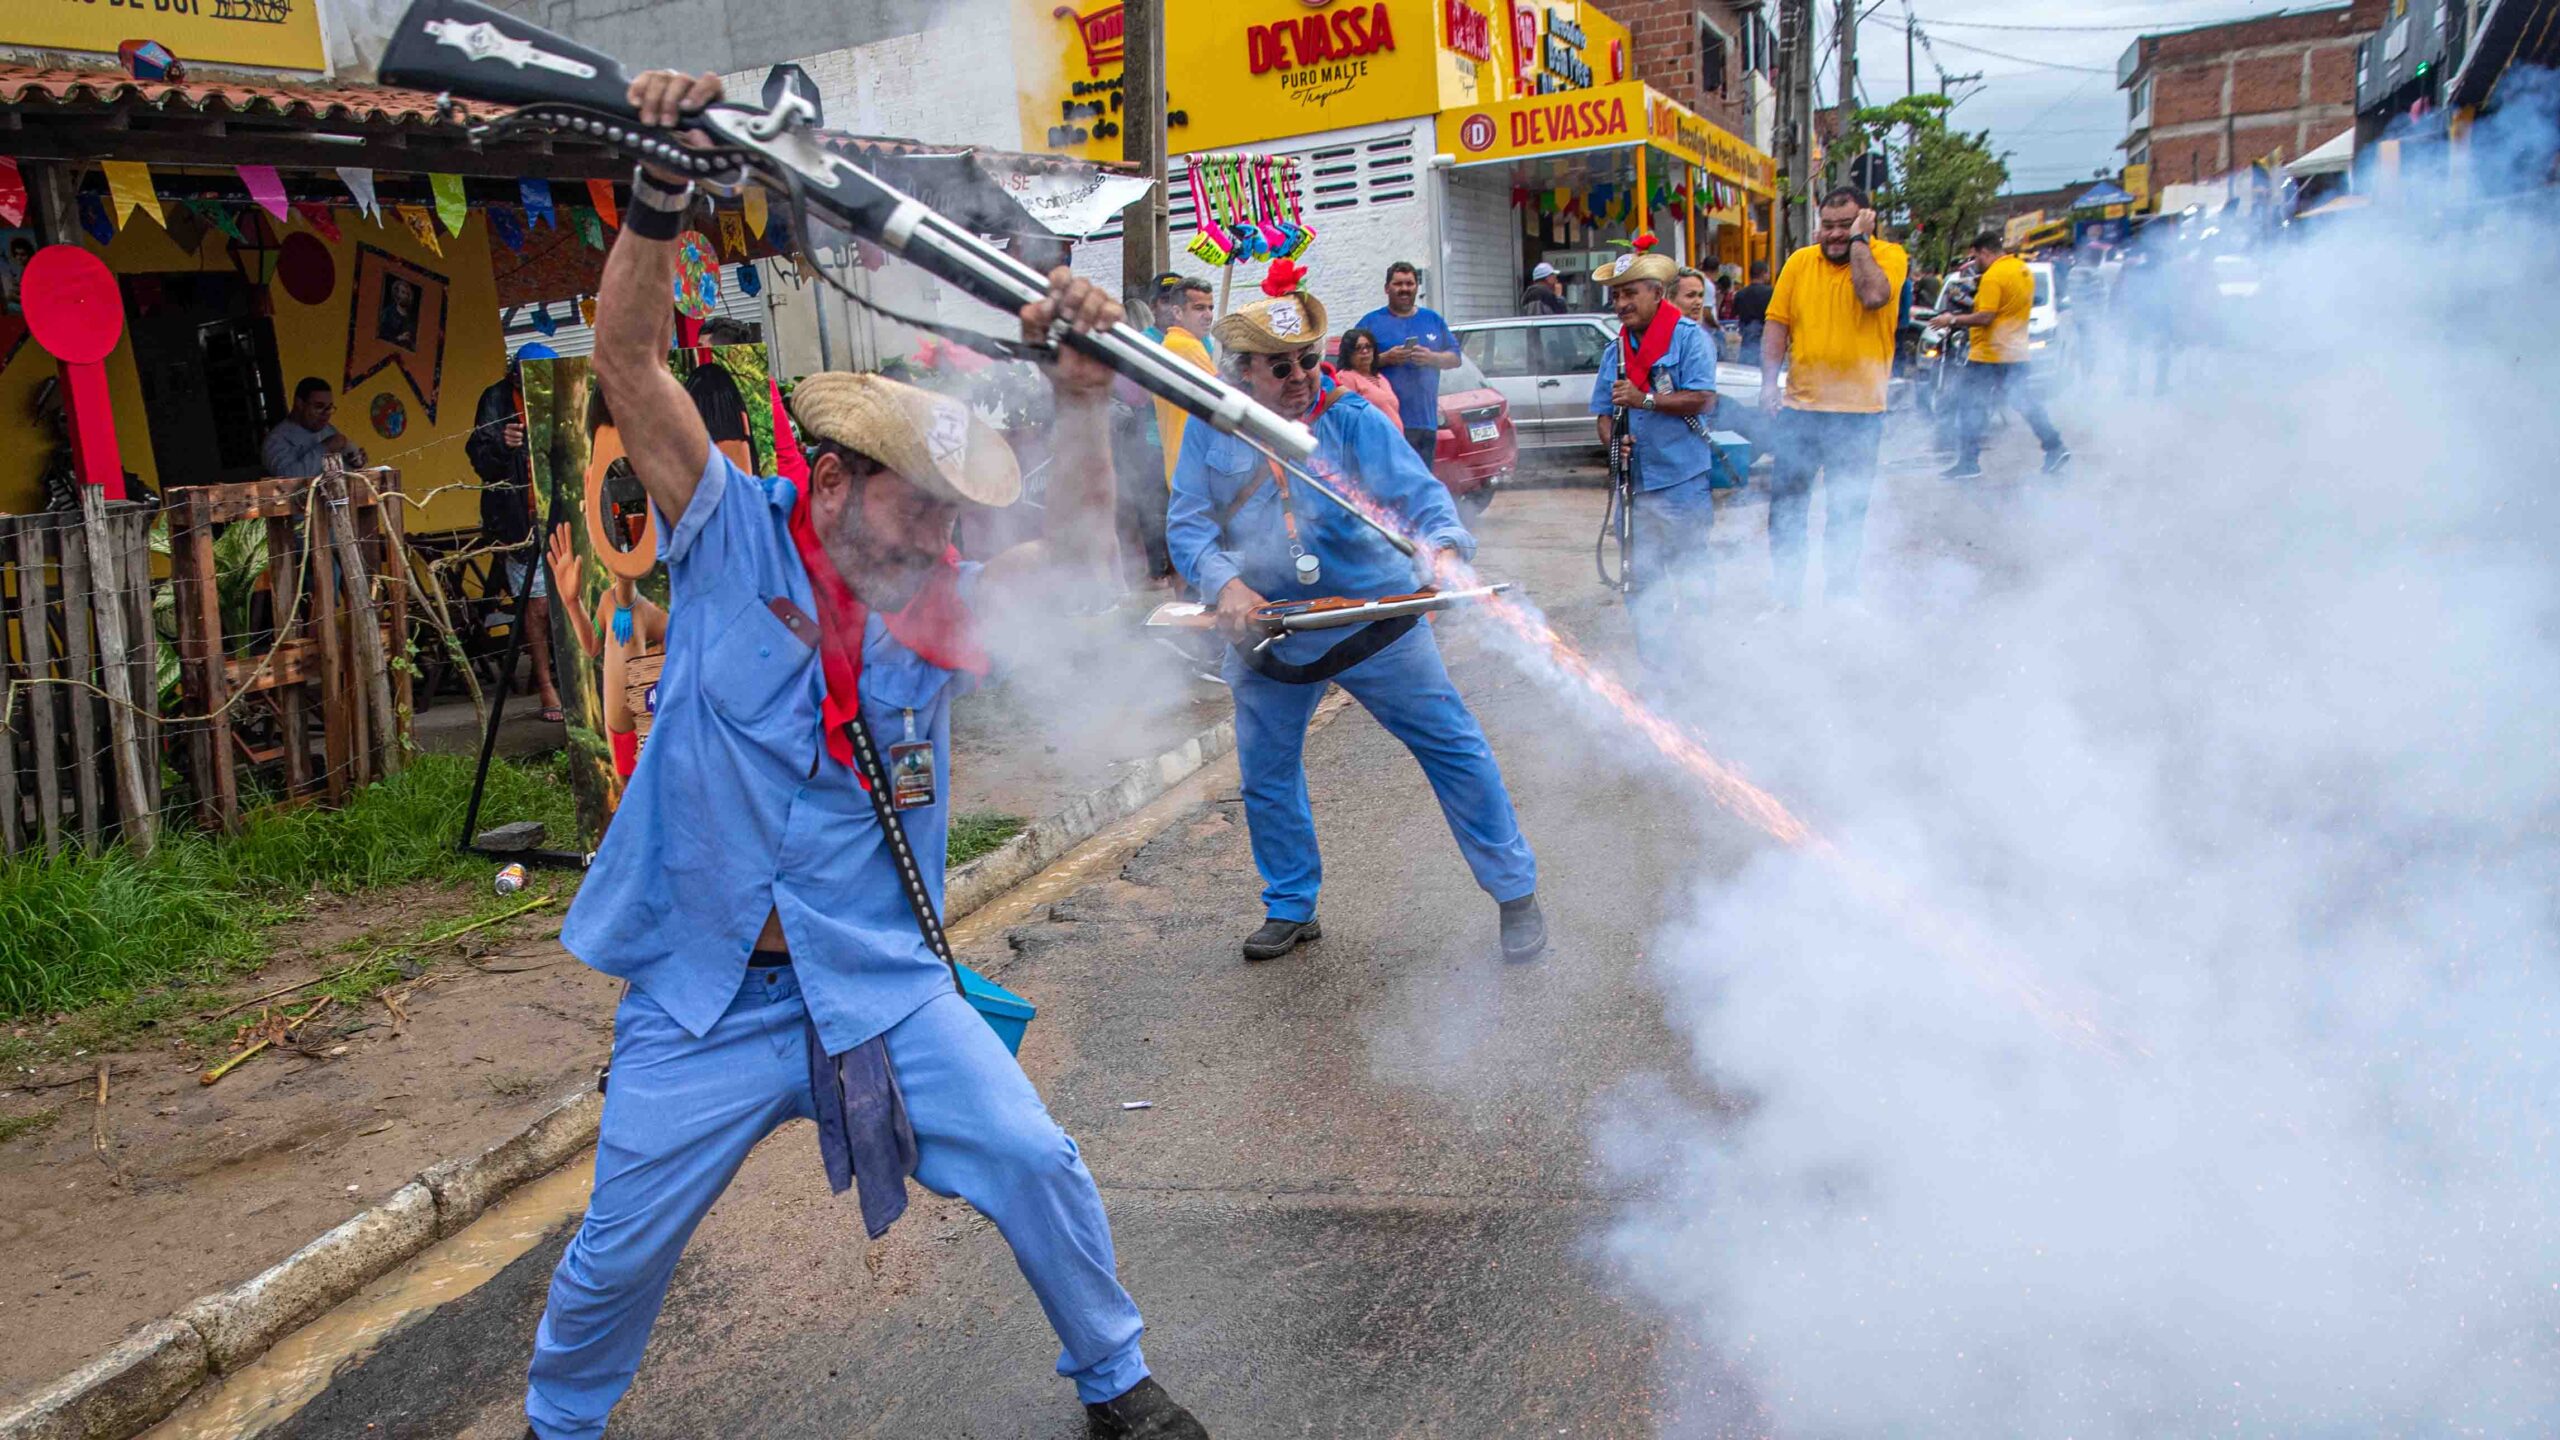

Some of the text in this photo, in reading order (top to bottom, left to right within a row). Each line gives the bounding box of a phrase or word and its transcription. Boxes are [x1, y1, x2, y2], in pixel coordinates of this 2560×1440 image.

[1248, 3, 1395, 74] DEVASSA
[1281, 61, 1368, 89] PURO MALTE
[1510, 98, 1627, 147] DEVASSA
